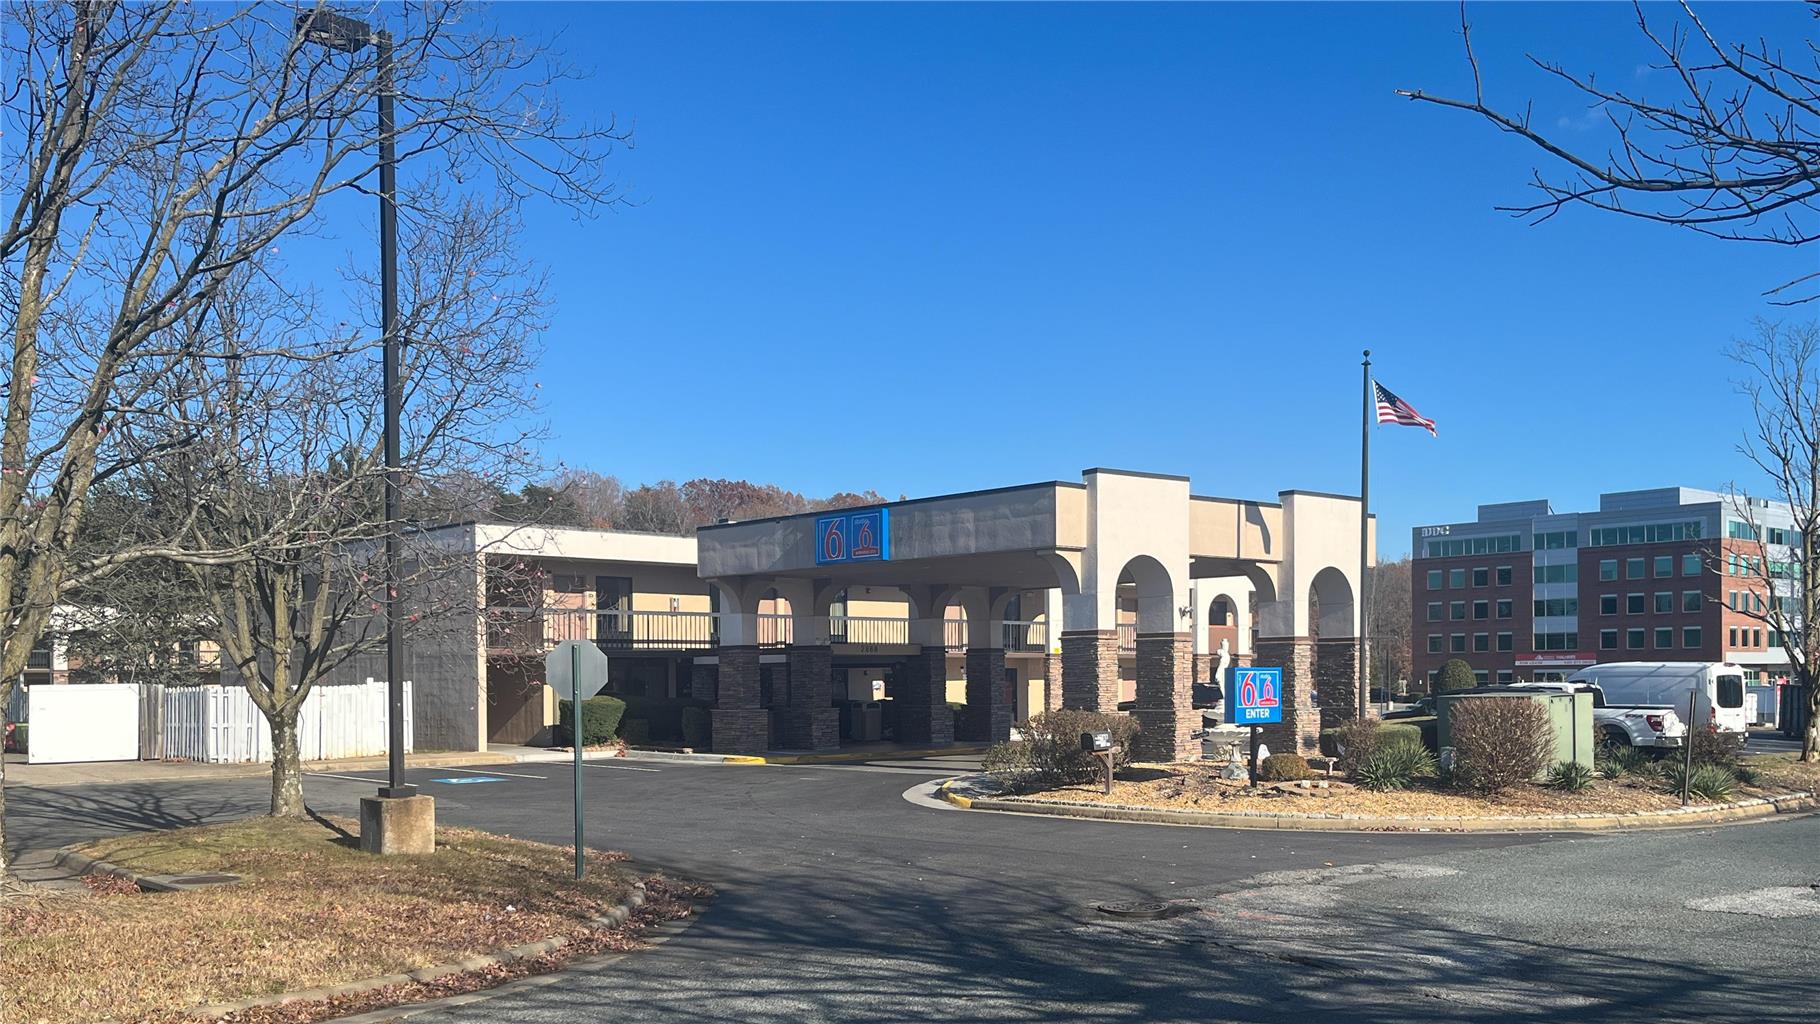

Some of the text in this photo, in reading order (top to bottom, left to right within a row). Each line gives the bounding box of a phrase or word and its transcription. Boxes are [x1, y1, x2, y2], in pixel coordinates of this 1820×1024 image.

[825, 519, 844, 561] 6
[859, 519, 872, 549] 6
[1241, 671, 1257, 708] 6
[1263, 676, 1274, 700] 6
[1245, 708, 1270, 719] ENTER
